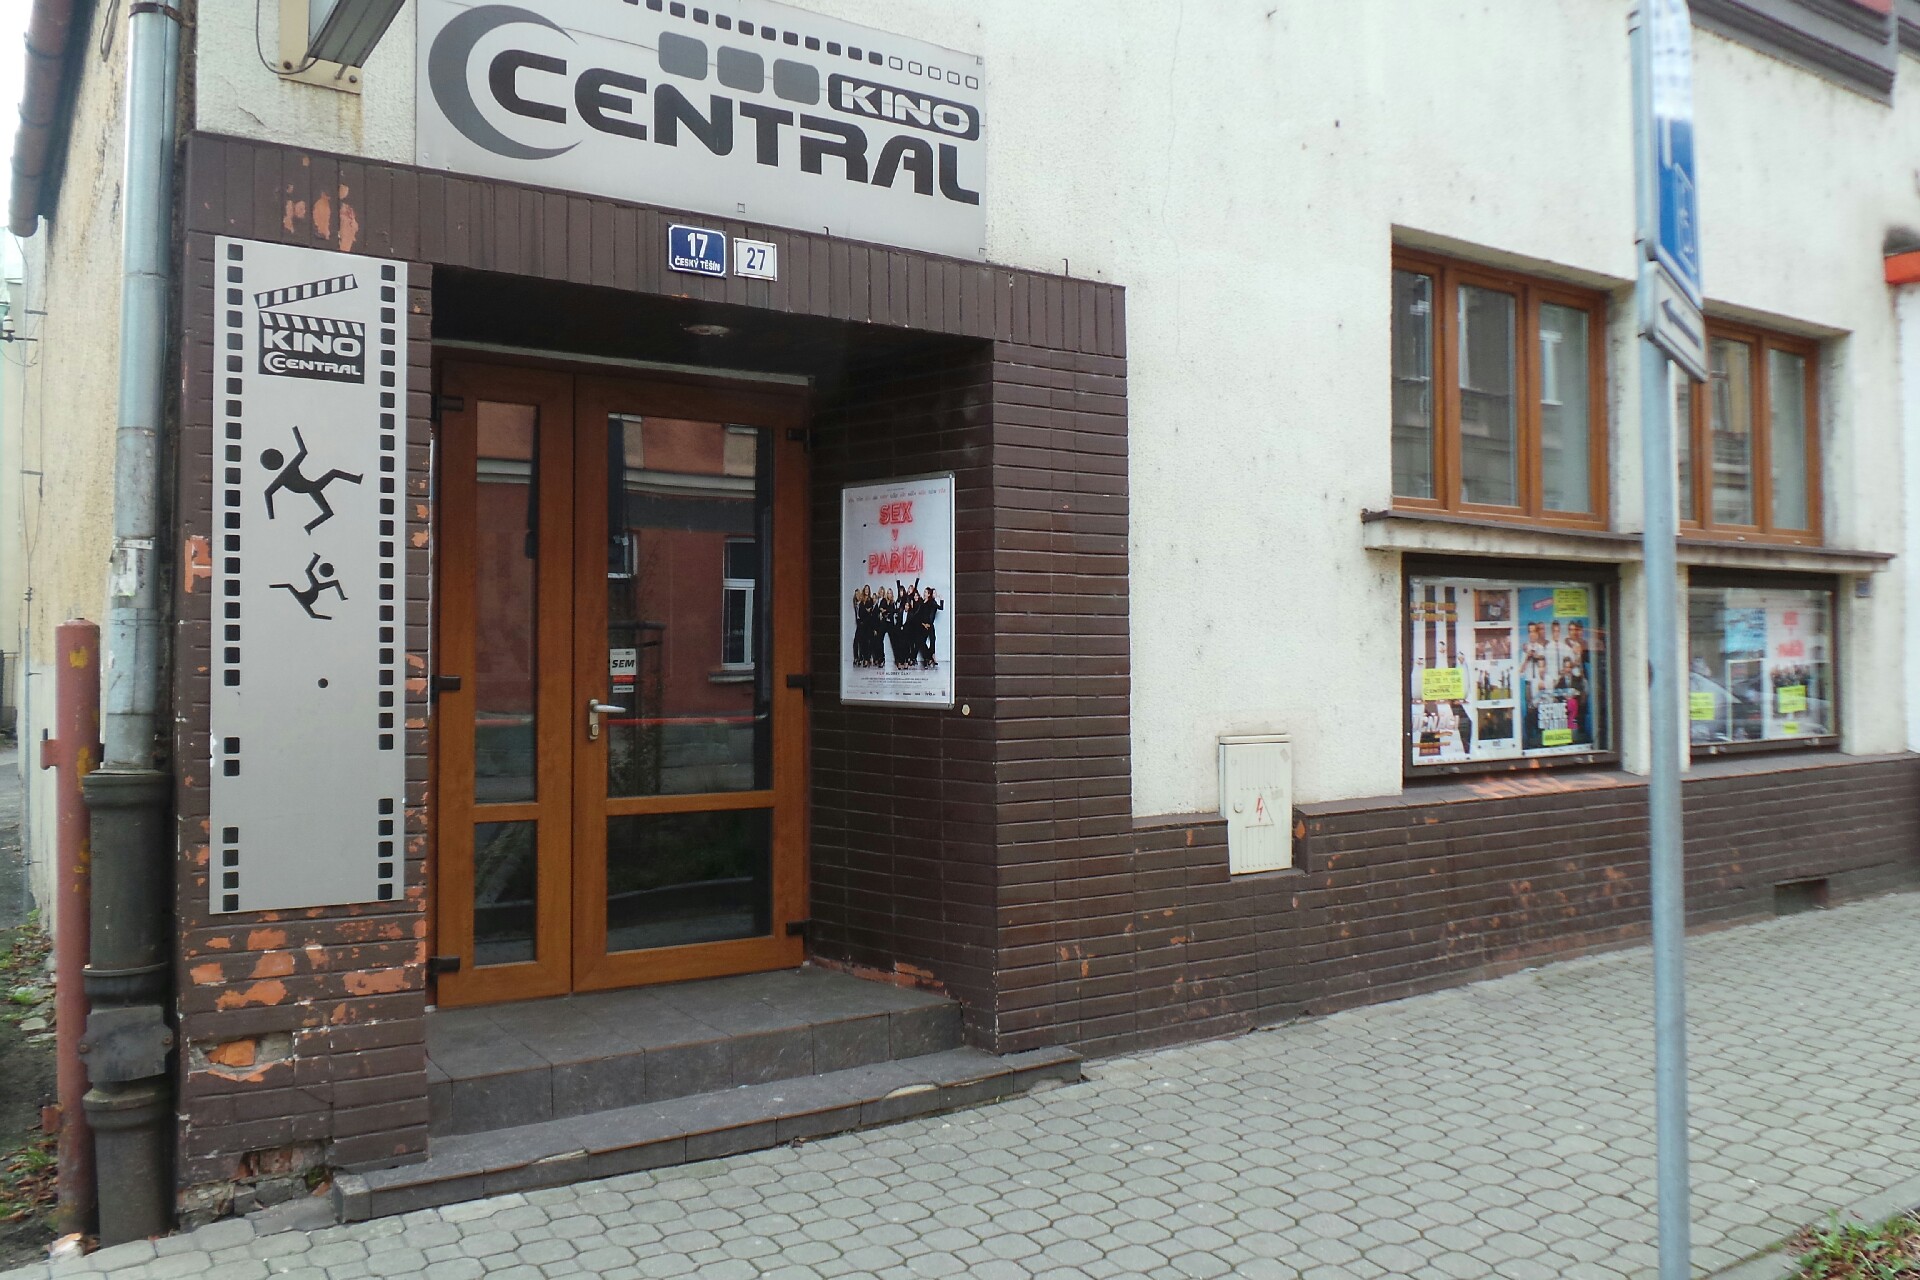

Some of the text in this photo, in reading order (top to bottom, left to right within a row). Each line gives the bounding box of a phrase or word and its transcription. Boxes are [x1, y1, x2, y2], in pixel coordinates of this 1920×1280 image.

[841, 79, 971, 134] KINO
[487, 49, 980, 206] CENTRAL
[687, 232, 708, 258] 17
[675, 256, 720, 271] ČESKÝ TĚŠÍN
[746, 247, 766, 271] 27
[263, 328, 361, 357] KINO
[270, 355, 361, 375] CENTRAL
[879, 500, 914, 525] SEX
[611, 659, 635, 669] SEM
